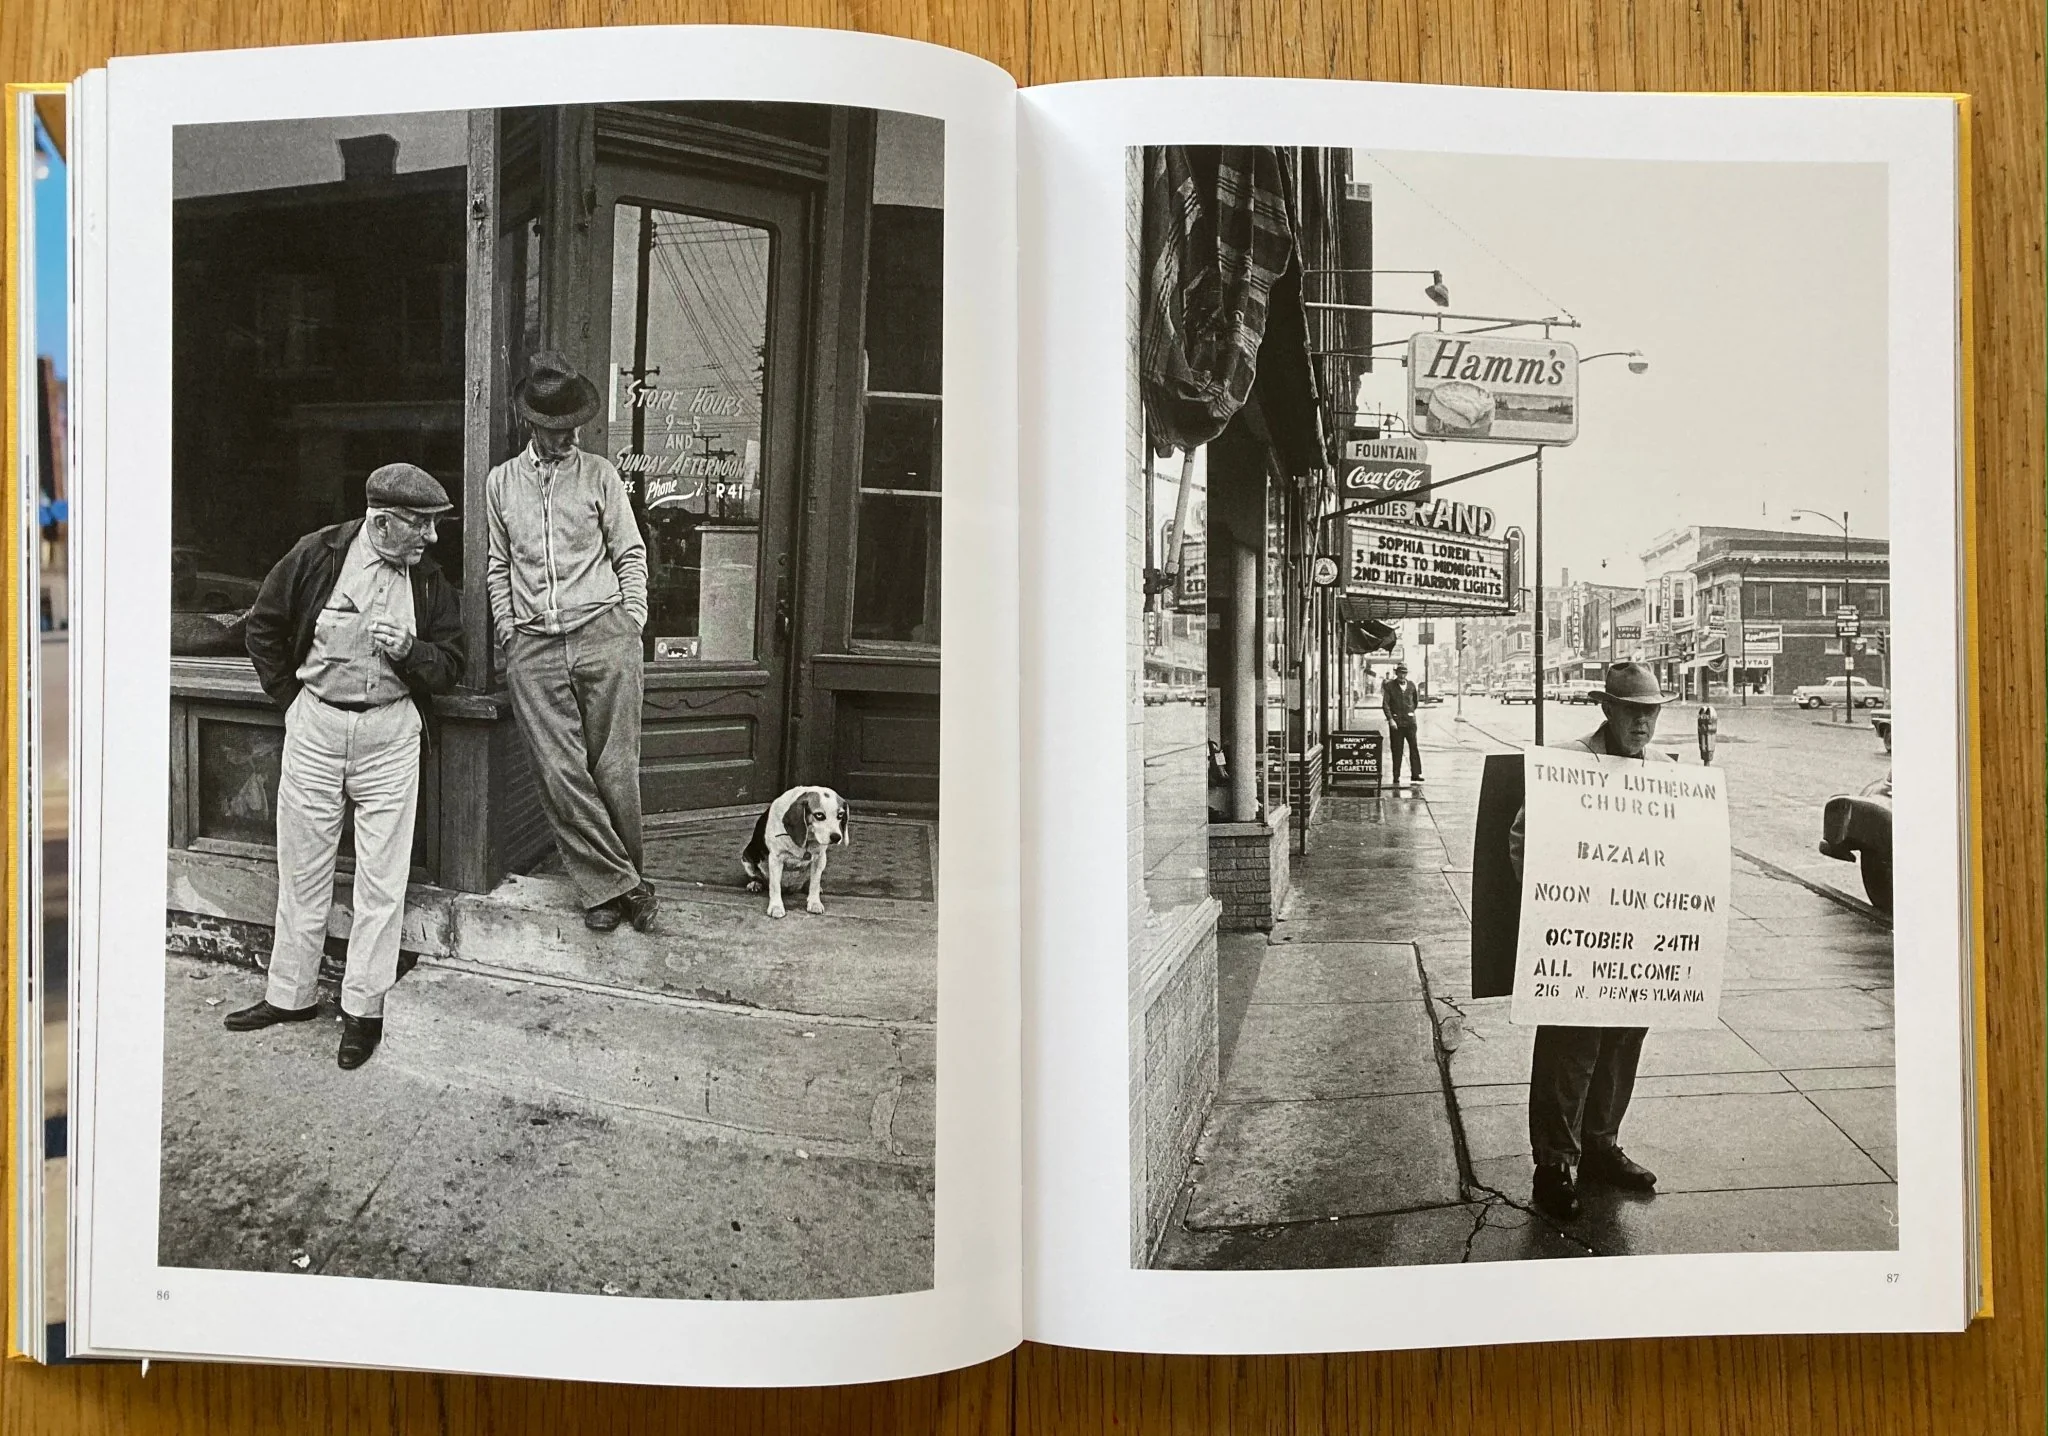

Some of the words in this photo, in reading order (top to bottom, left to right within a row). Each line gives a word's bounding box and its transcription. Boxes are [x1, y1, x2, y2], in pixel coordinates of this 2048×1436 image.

[1423, 338, 1566, 386] Hamm's
[624, 379, 683, 411] STORE
[689, 387, 745, 417] HOURS
[665, 433, 694, 450] AND
[1355, 443, 1417, 461] FOUNTAIN
[615, 445, 668, 475] SUNDAY
[667, 451, 747, 478] AFTERNOON
[646, 479, 678, 501] Phone
[1346, 465, 1425, 492] Coca-Cola
[1377, 536, 1425, 555] SOPHIA
[1432, 543, 1470, 561] LOREN
[1356, 549, 1365, 563] 5
[1369, 551, 1408, 569] MILES
[1412, 557, 1429, 571] TO
[1433, 559, 1487, 579] MIDNIGHT
[1353, 566, 1381, 582] 2ND
[1385, 570, 1406, 585] HIT
[1414, 573, 1460, 591] HARBOR
[1463, 579, 1502, 596] LIGHTS
[1661, 576, 1670, 632] SHOES
[1534, 763, 1610, 788] TRINITY
[1623, 773, 1717, 800] LUTHERAN
[1580, 793, 1676, 819] CHURCH
[1577, 840, 1666, 867] BAZAAR
[1534, 882, 1590, 904] NOON
[1545, 928, 1634, 950] OCTOBER
[1653, 933, 1700, 952] 24TH
[1533, 958, 1573, 978] ALL
[1534, 983, 1560, 998] 216
[1575, 984, 1590, 999] N.
[1599, 985, 1704, 1003] PENNSYLVANIA
[1886, 1273, 1900, 1283] 87
[156, 1290, 170, 1301] 86
